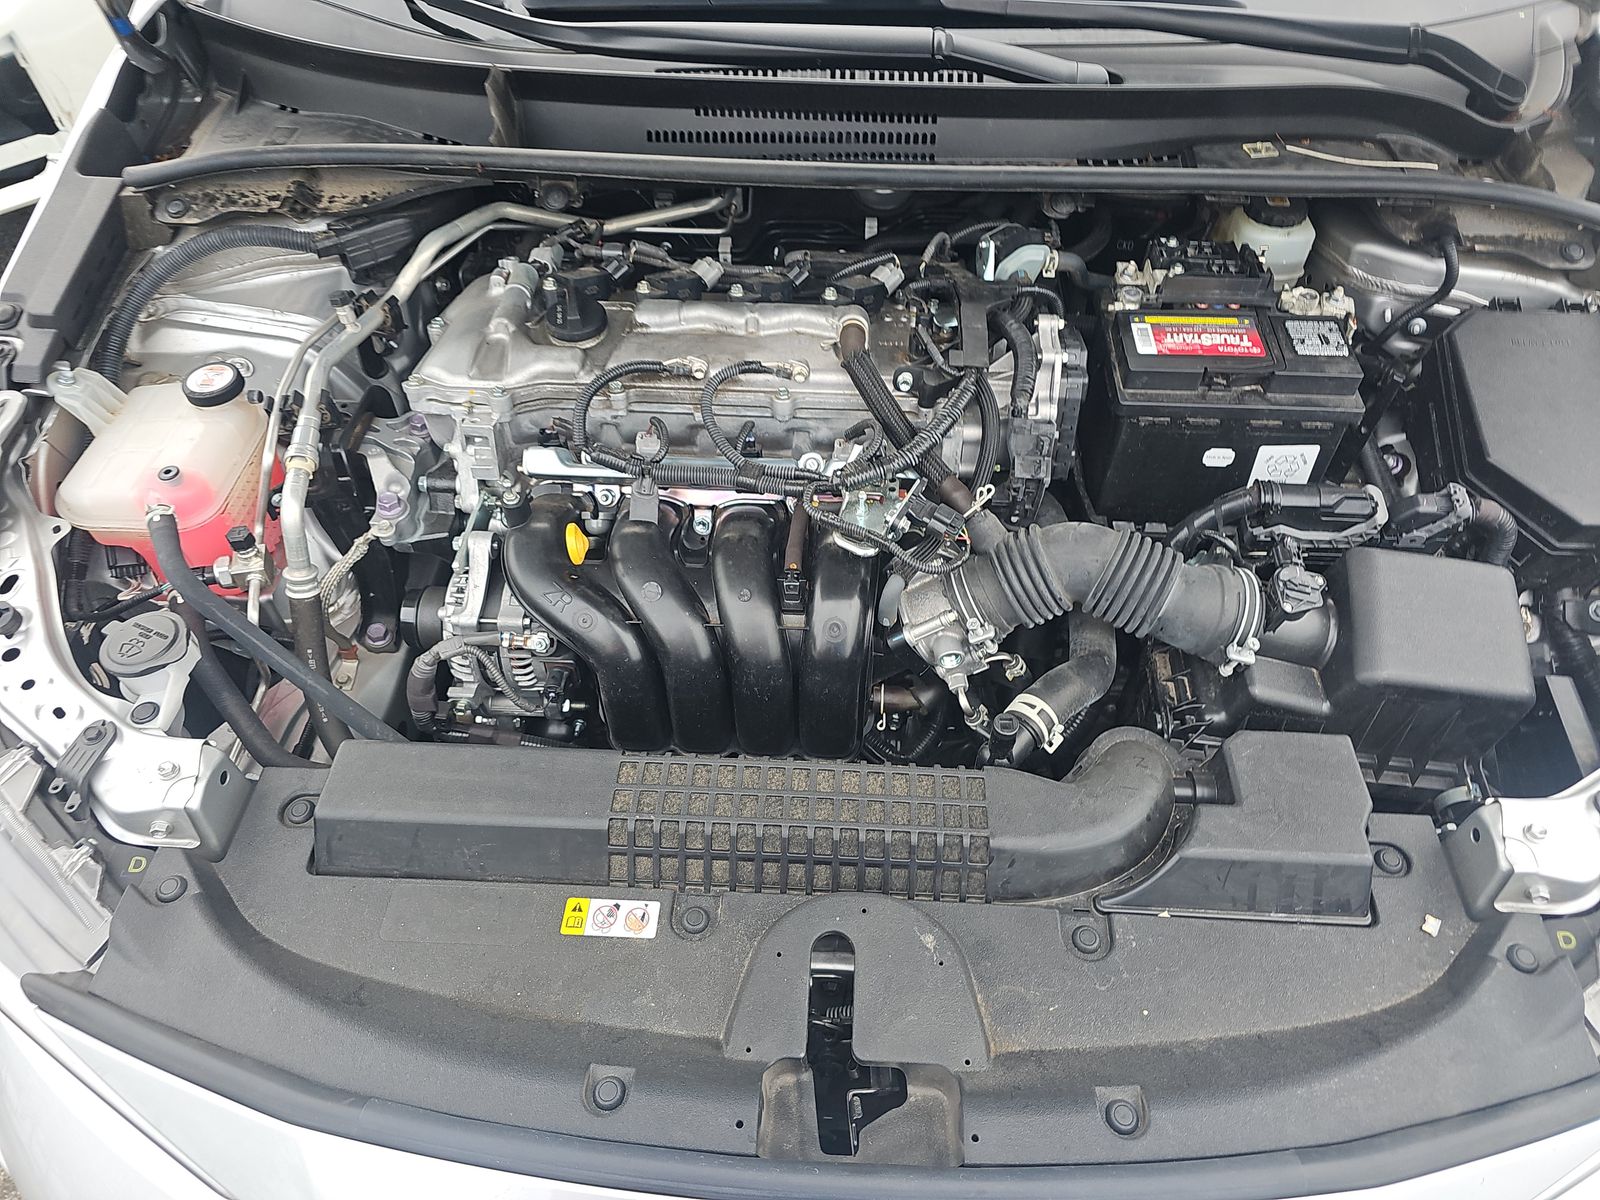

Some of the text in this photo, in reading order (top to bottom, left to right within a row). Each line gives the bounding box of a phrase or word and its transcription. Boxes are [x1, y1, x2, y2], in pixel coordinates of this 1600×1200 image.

[1218, 345, 1249, 354] TOYOTA
[543, 581, 573, 614] ZR
[128, 856, 147, 873] D
[1556, 930, 1577, 949] D
